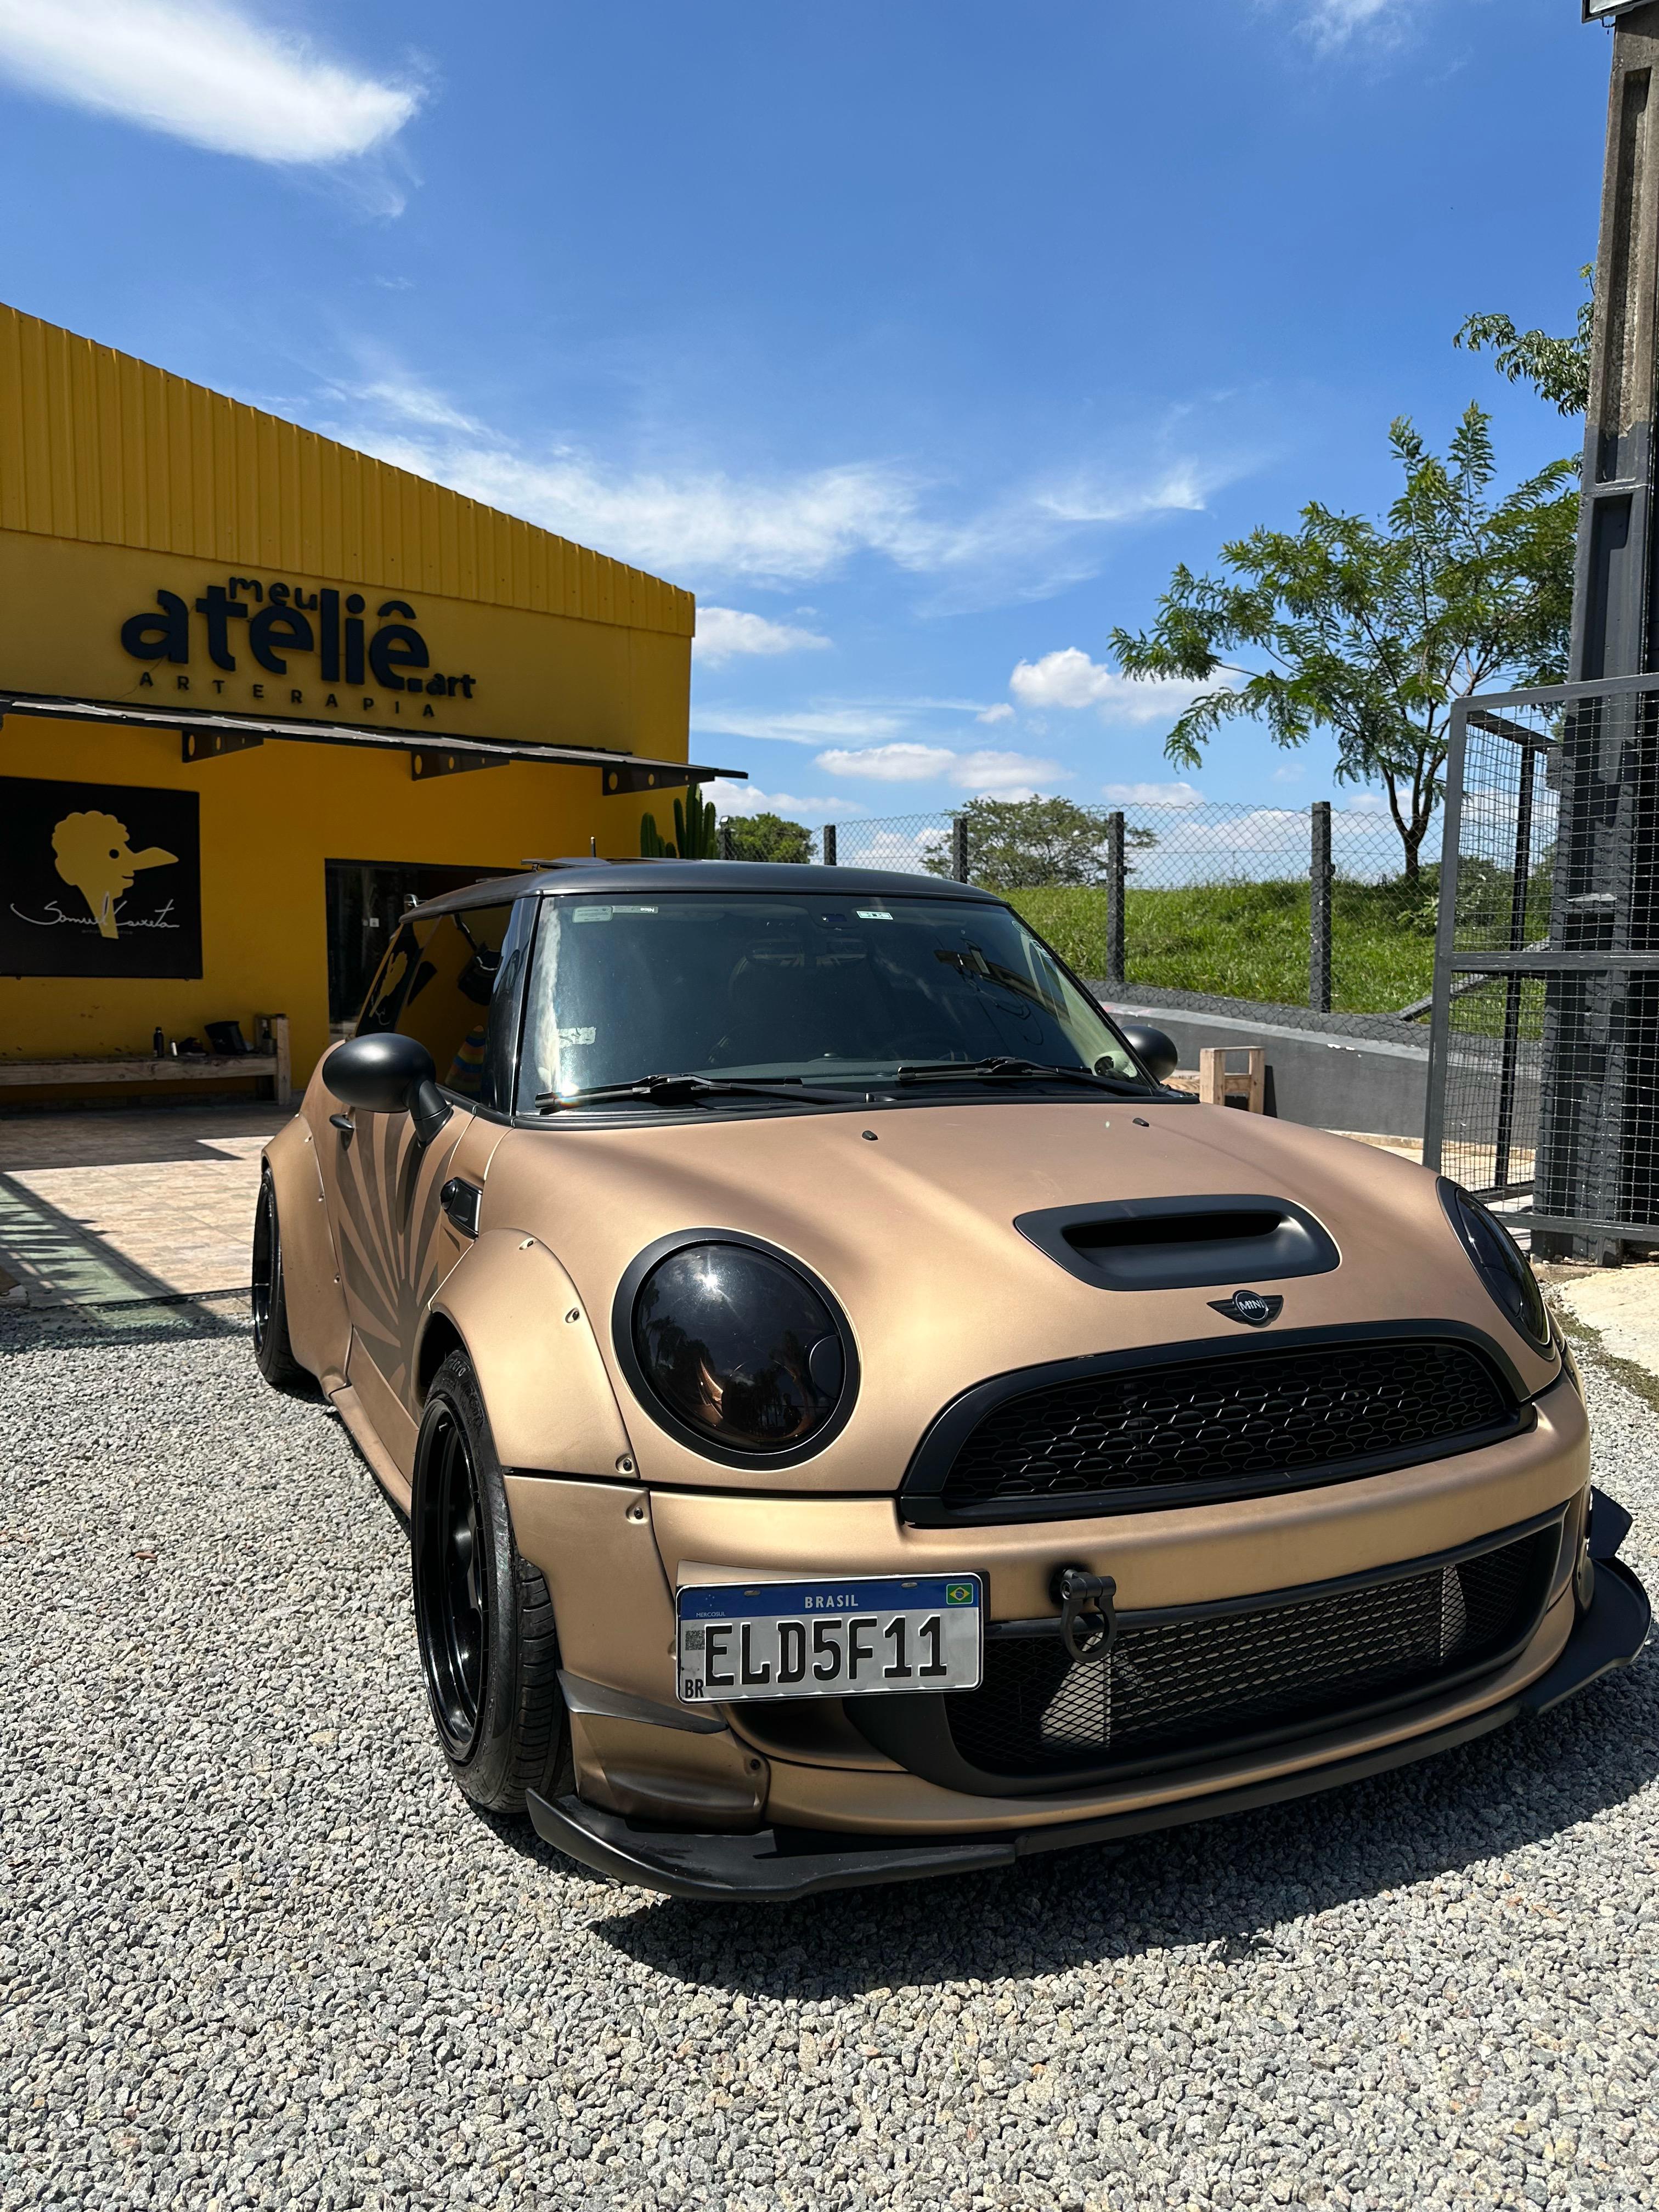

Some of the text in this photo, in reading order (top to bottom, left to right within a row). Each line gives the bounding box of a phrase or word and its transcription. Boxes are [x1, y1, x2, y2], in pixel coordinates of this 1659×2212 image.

[229, 577, 319, 611] meu
[120, 585, 430, 691] ateliê
[139, 671, 435, 718] ARTERAPIA
[1238, 1299, 1265, 1311] MINI
[804, 1594, 859, 1609] BRASIL
[704, 1615, 947, 1687] ELD5F11
[685, 1678, 704, 1699] BR
